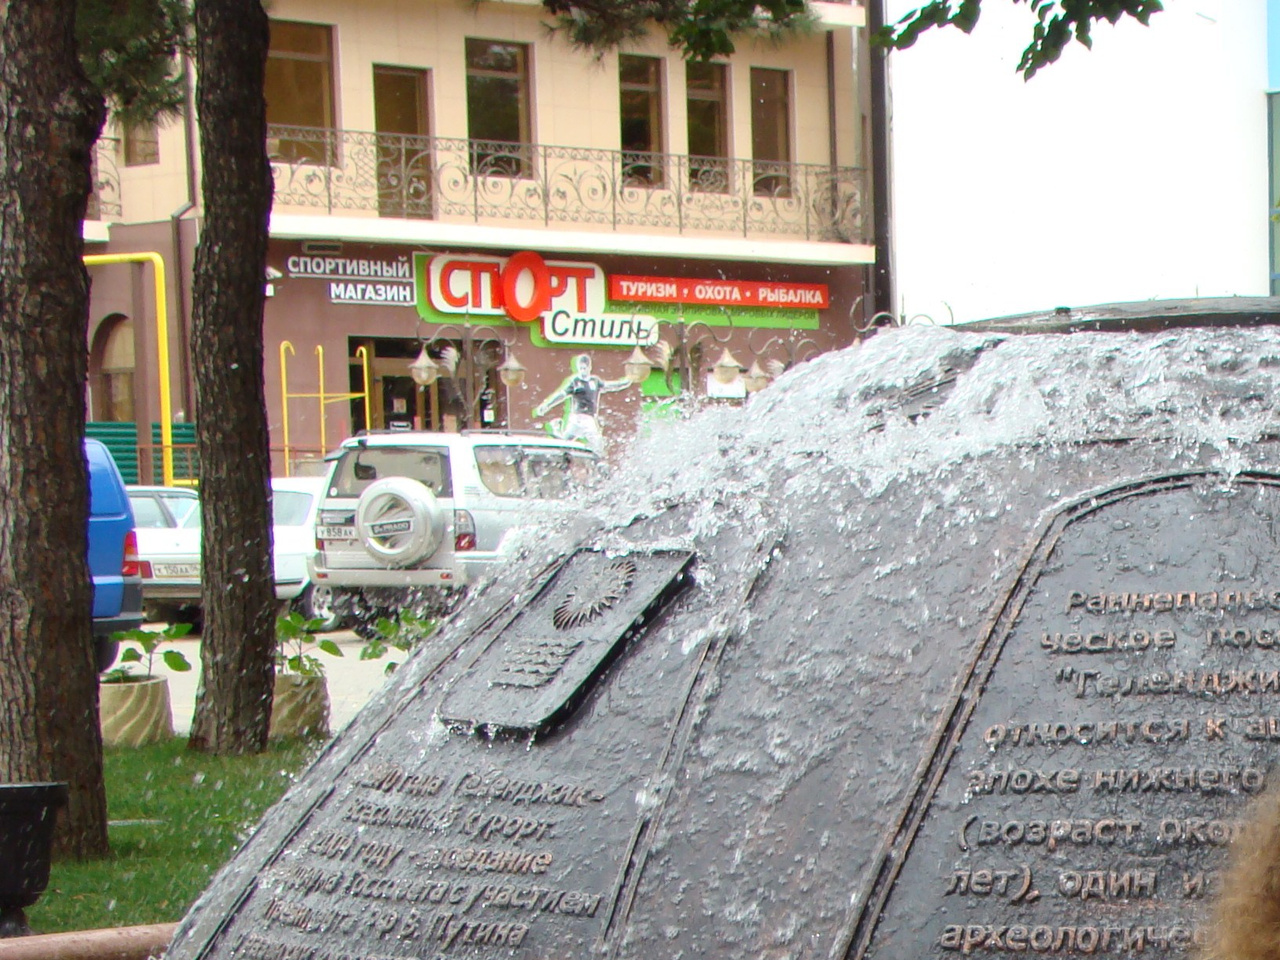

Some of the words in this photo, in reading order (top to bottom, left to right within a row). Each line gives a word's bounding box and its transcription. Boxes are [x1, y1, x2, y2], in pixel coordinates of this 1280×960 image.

[287, 255, 410, 278] СПОРТИВНЫЙ
[330, 282, 411, 301] МАГАЗИН
[440, 250, 595, 322] СПОРТ
[620, 281, 677, 298] ТУРИЗМ
[695, 284, 741, 301] ОХОТА
[758, 287, 823, 304] РЫБАЛКА
[551, 310, 652, 340] Стиль
[1040, 628, 1176, 653] ческое
[982, 716, 1191, 747] относится
[1206, 717, 1225, 741] к
[966, 767, 1078, 796] эпохе
[1094, 767, 1266, 796] нижнего
[958, 815, 1140, 851] (возраст
[1058, 869, 1156, 899] один
[941, 925, 1204, 953] археологиче
